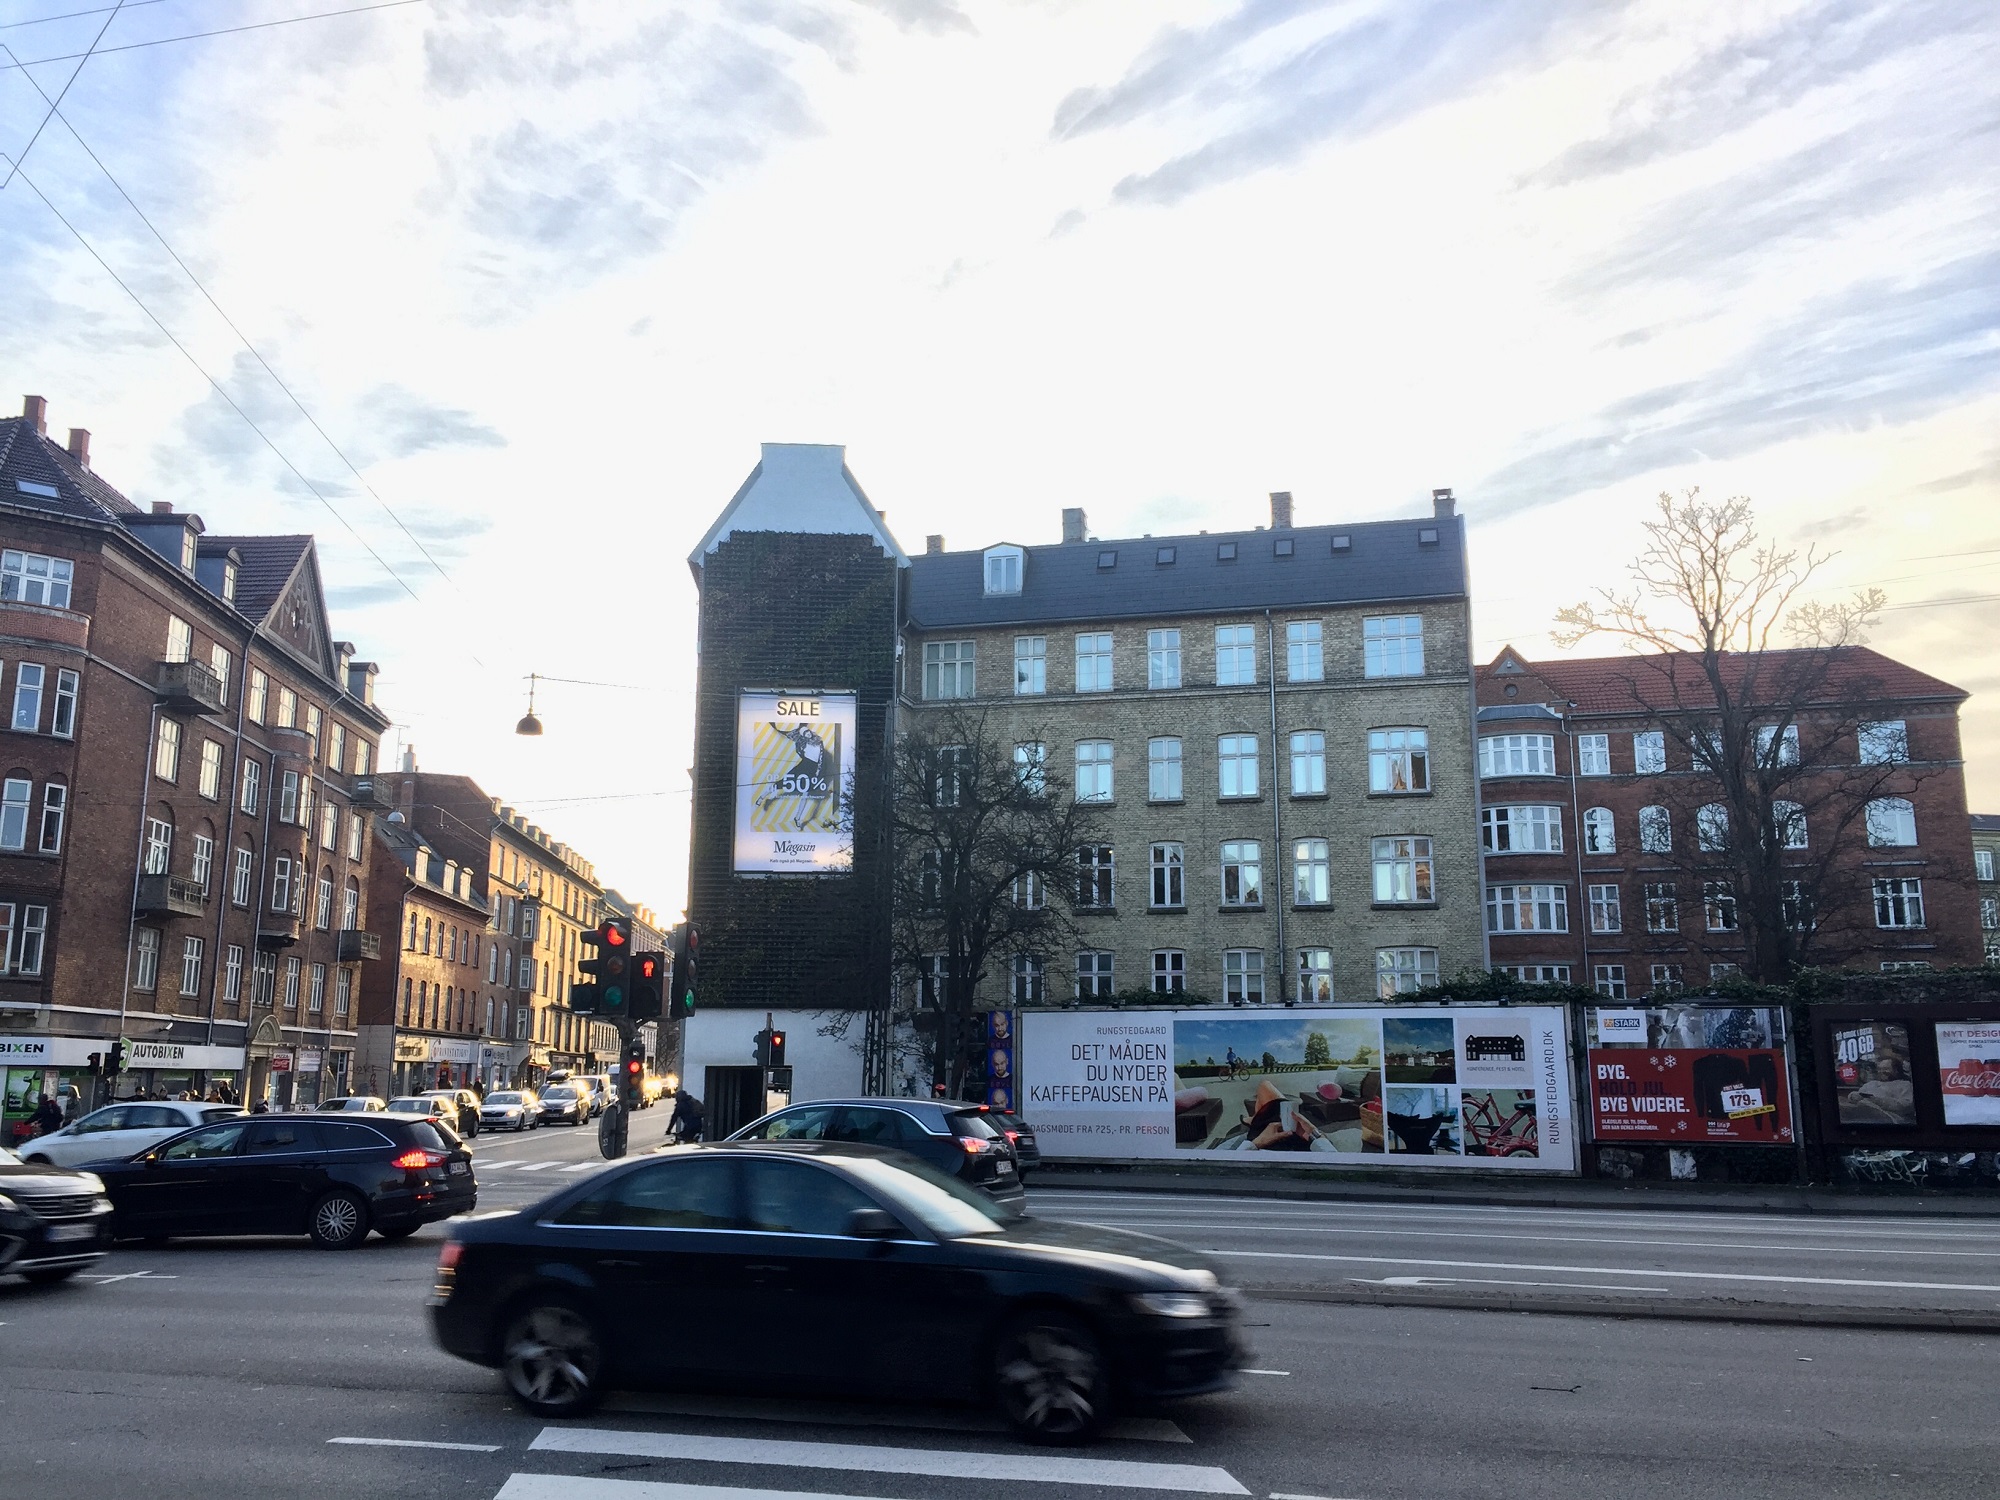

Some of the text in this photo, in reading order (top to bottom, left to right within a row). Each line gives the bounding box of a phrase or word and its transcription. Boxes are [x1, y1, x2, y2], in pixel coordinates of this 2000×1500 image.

[777, 701, 820, 716] SALE
[782, 774, 827, 793] 50%
[774, 840, 816, 856] Magasin
[1096, 1026, 1167, 1035] RUNGSTEDGAARD
[1614, 1019, 1640, 1027] STARK
[1943, 1030, 2000, 1038] NYT DESIG
[132, 1046, 184, 1060] AUTOBIXEN
[1109, 1038, 1167, 1061] MÅDEN
[1837, 1034, 1875, 1063] 40 GB
[1087, 1065, 1167, 1081] DU NYDER
[1597, 1064, 1630, 1080] BYG.
[1030, 1081, 1169, 1102] KAFFEPAUSEN PÅ
[1543, 1030, 1560, 1145] RUNGSTEDGAARD.DK
[1599, 1081, 1672, 1096] HOLD JUL.
[1600, 1097, 1690, 1113] BYG VIDERE.
[1031, 1124, 1074, 1134] DAGSMØDE
[1076, 1125, 1093, 1134] FRA
[1119, 1125, 1133, 1134] PR.
[1135, 1126, 1170, 1135] PERSON
